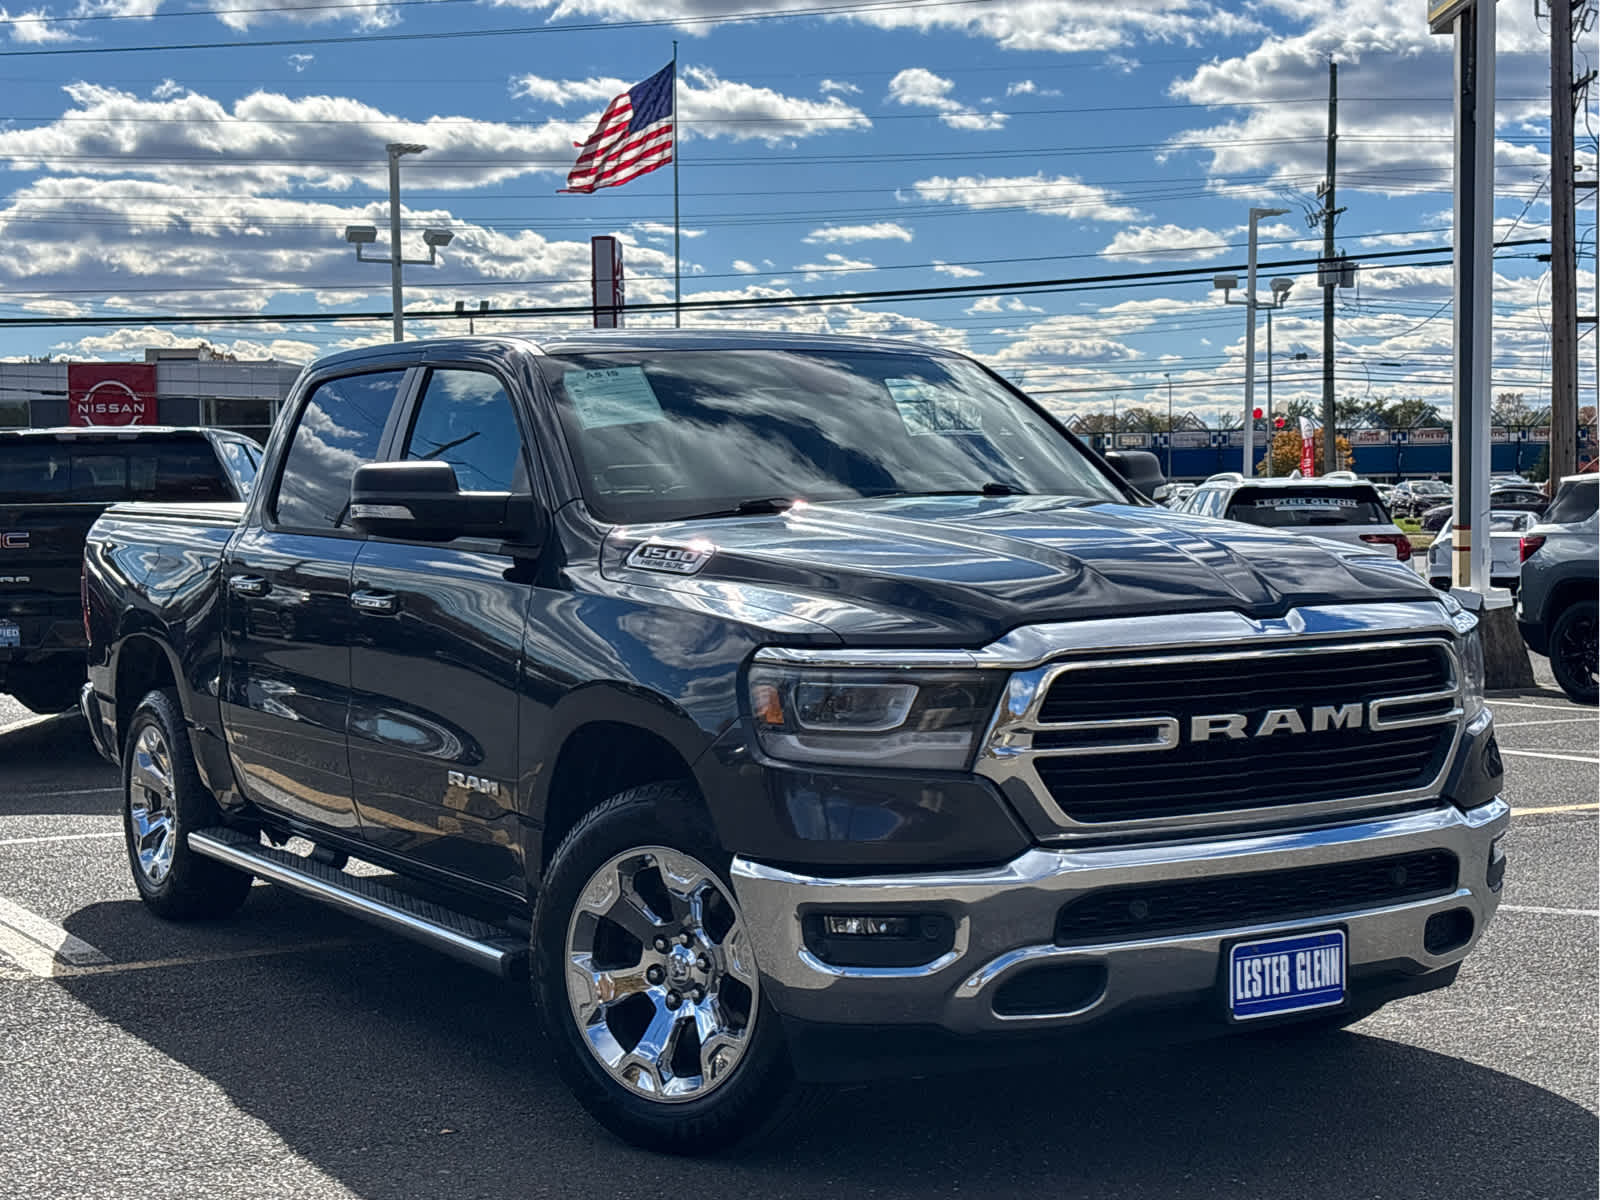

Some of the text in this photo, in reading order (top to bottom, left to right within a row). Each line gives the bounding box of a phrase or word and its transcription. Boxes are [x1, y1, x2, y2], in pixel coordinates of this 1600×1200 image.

[586, 371, 603, 379] AS
[77, 403, 145, 414] NISSAN
[1255, 498, 1360, 508] LESTER GLENN
[643, 546, 699, 562] 1500
[640, 558, 664, 567] HEMI
[1190, 702, 1363, 742] RAM
[447, 770, 498, 796] RAM
[1236, 947, 1340, 999] LESTER GLENN
